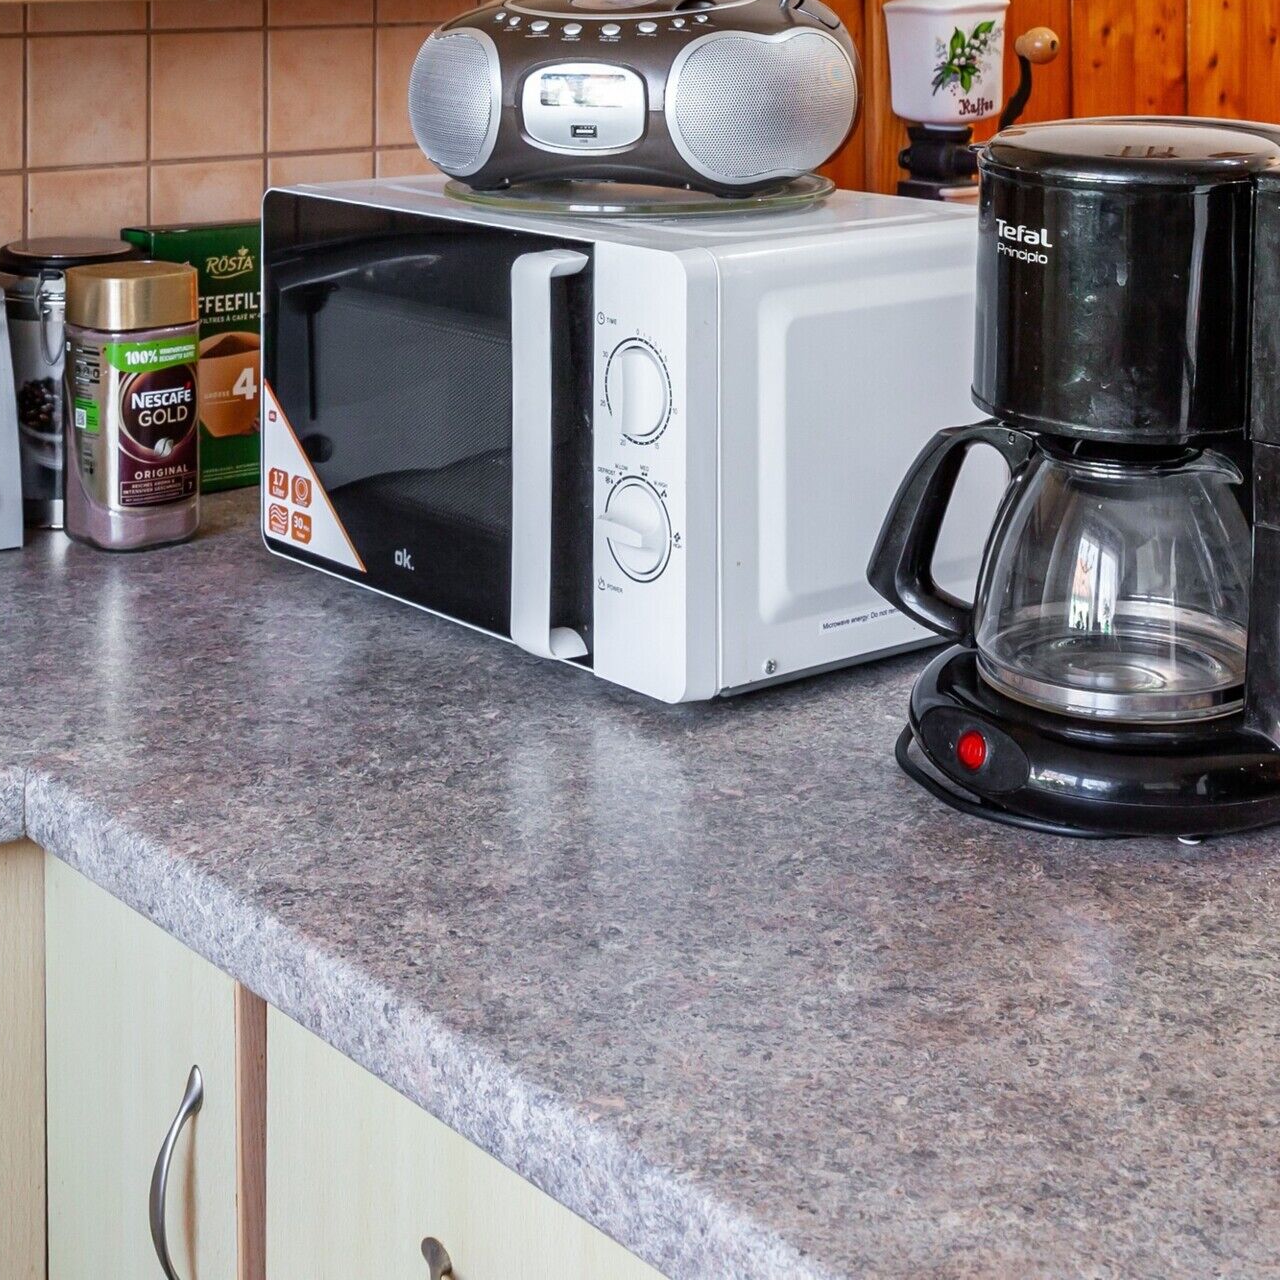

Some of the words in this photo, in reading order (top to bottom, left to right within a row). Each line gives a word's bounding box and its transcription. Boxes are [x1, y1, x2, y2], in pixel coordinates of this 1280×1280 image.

[958, 97, 994, 116] Kaffee
[995, 218, 1053, 248] Tefal
[997, 242, 1048, 264] Principio
[206, 255, 254, 274] RÖSTA
[125, 349, 159, 366] 100%
[232, 367, 257, 401] 4
[131, 382, 192, 410] NESCAFÉ
[138, 405, 188, 427] GOLD
[134, 464, 189, 480] ORIGINAL
[273, 470, 284, 486] 17
